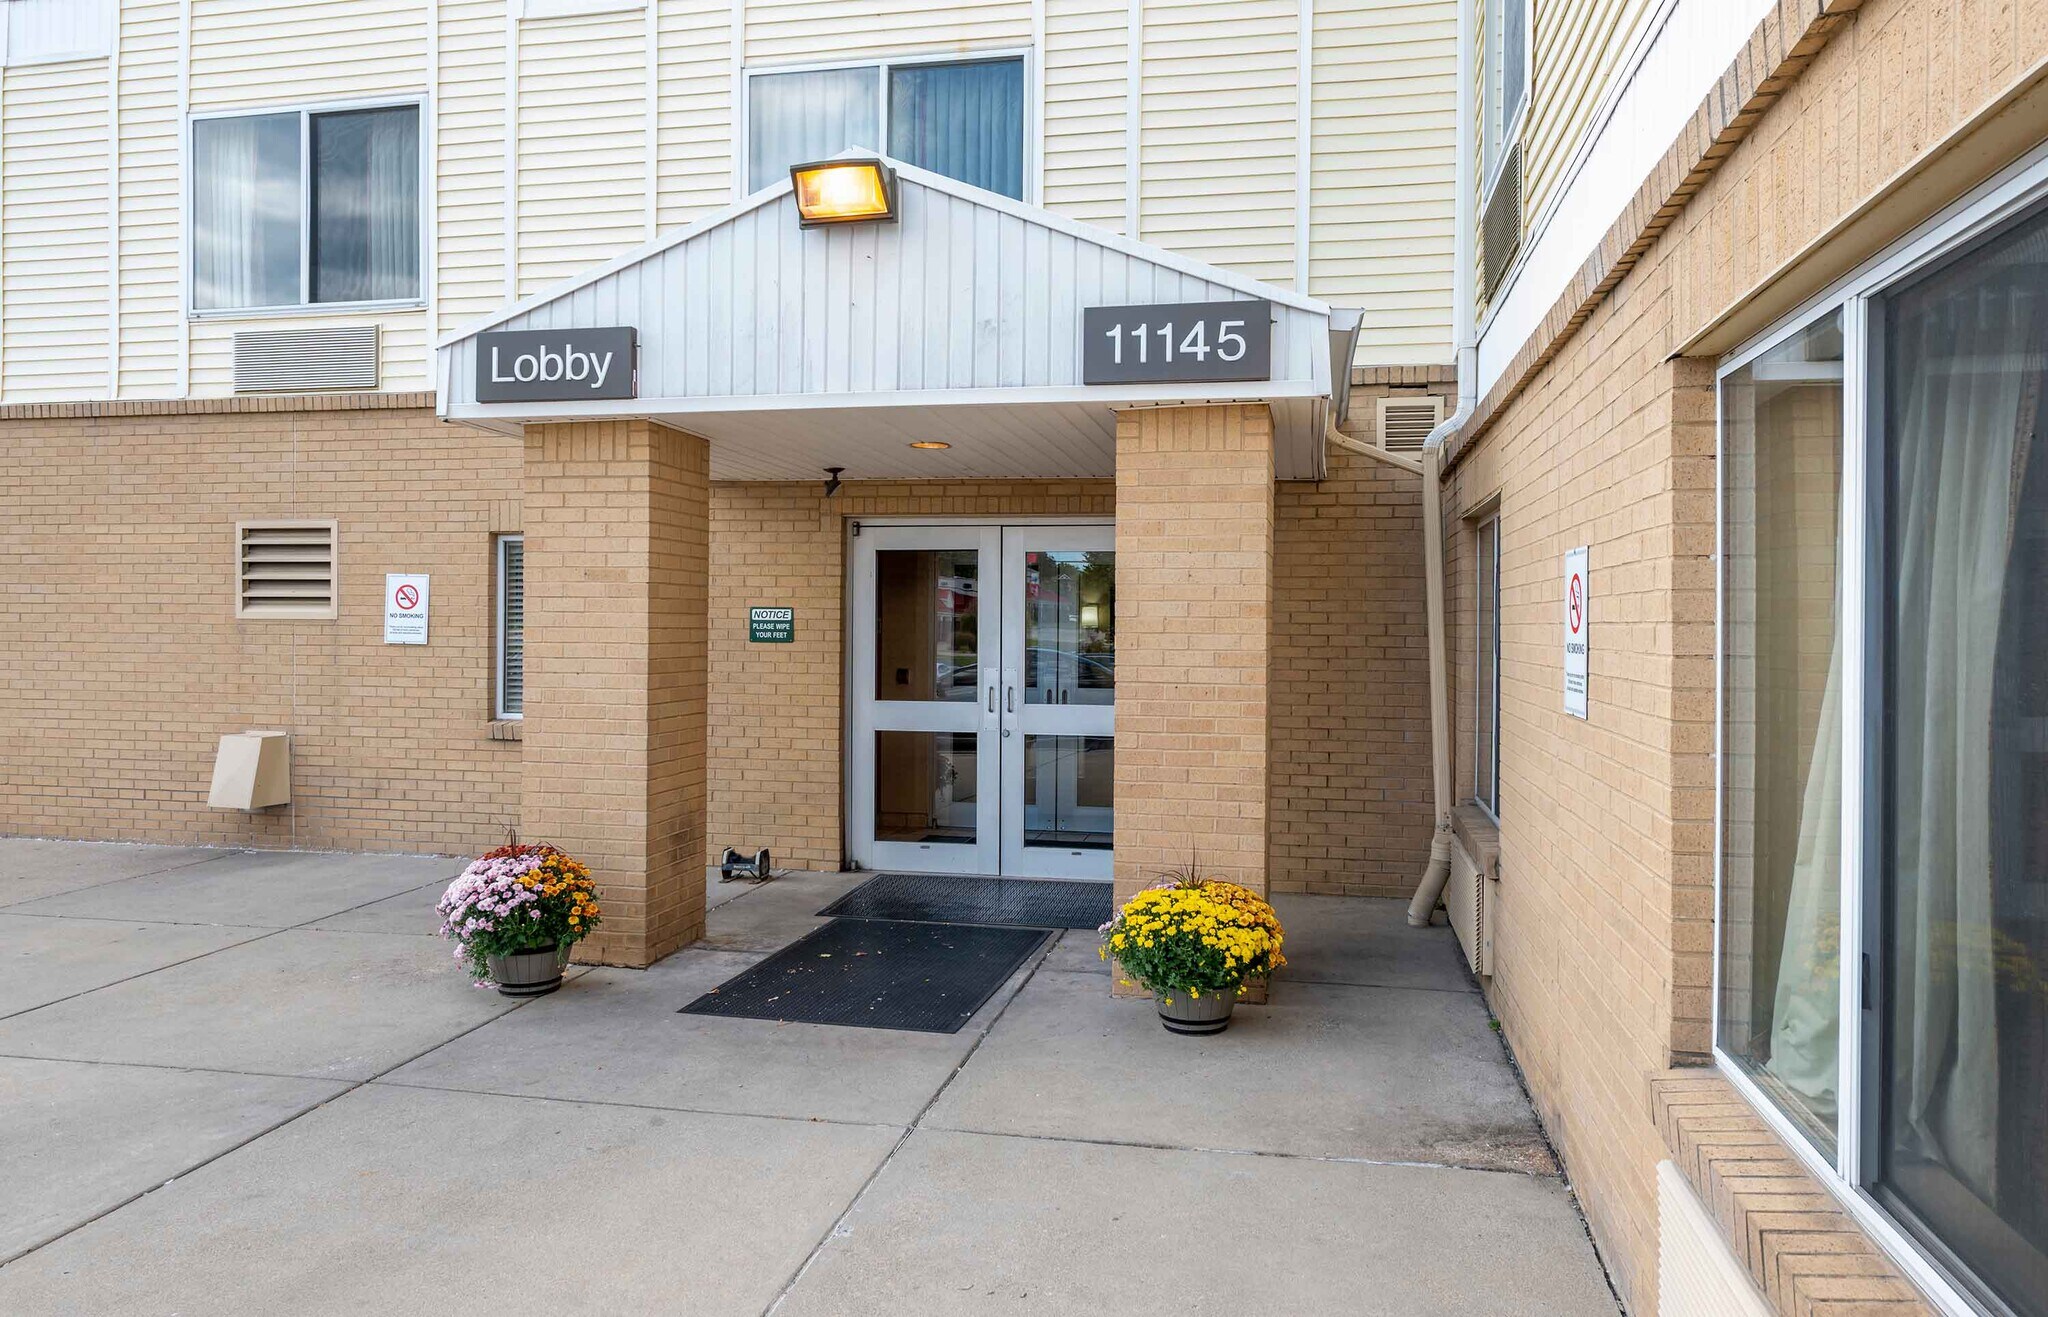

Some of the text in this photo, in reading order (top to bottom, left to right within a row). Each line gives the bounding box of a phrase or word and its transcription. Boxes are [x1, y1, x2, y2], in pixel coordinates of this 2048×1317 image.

[1105, 320, 1247, 364] 11145
[491, 343, 613, 389] Lobby
[752, 622, 775, 630] PLEASE
[753, 610, 790, 619] NOTICE
